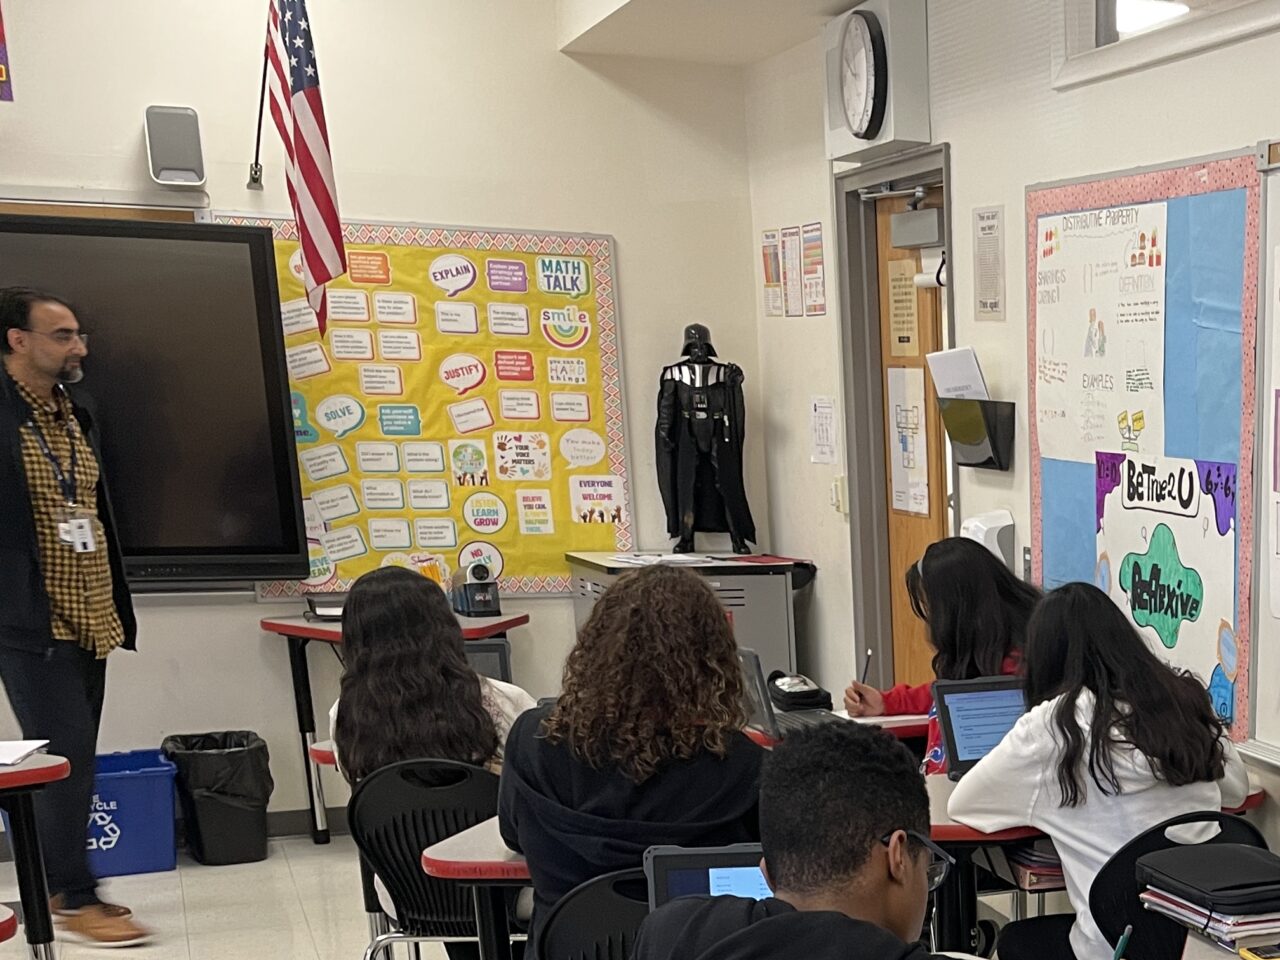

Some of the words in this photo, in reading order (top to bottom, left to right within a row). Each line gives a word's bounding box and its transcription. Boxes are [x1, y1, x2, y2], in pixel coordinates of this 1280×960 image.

[1105, 208, 1139, 226] PROPERTY
[432, 264, 471, 282] EXPLAIN
[541, 259, 581, 275] MATH
[543, 274, 581, 291] TALK
[543, 307, 587, 323] smile
[444, 364, 480, 380] JUSTIFY
[324, 405, 353, 421] SOLVE
[472, 509, 499, 517] LEARN
[473, 518, 499, 527] GROW
[471, 549, 483, 559] NO
